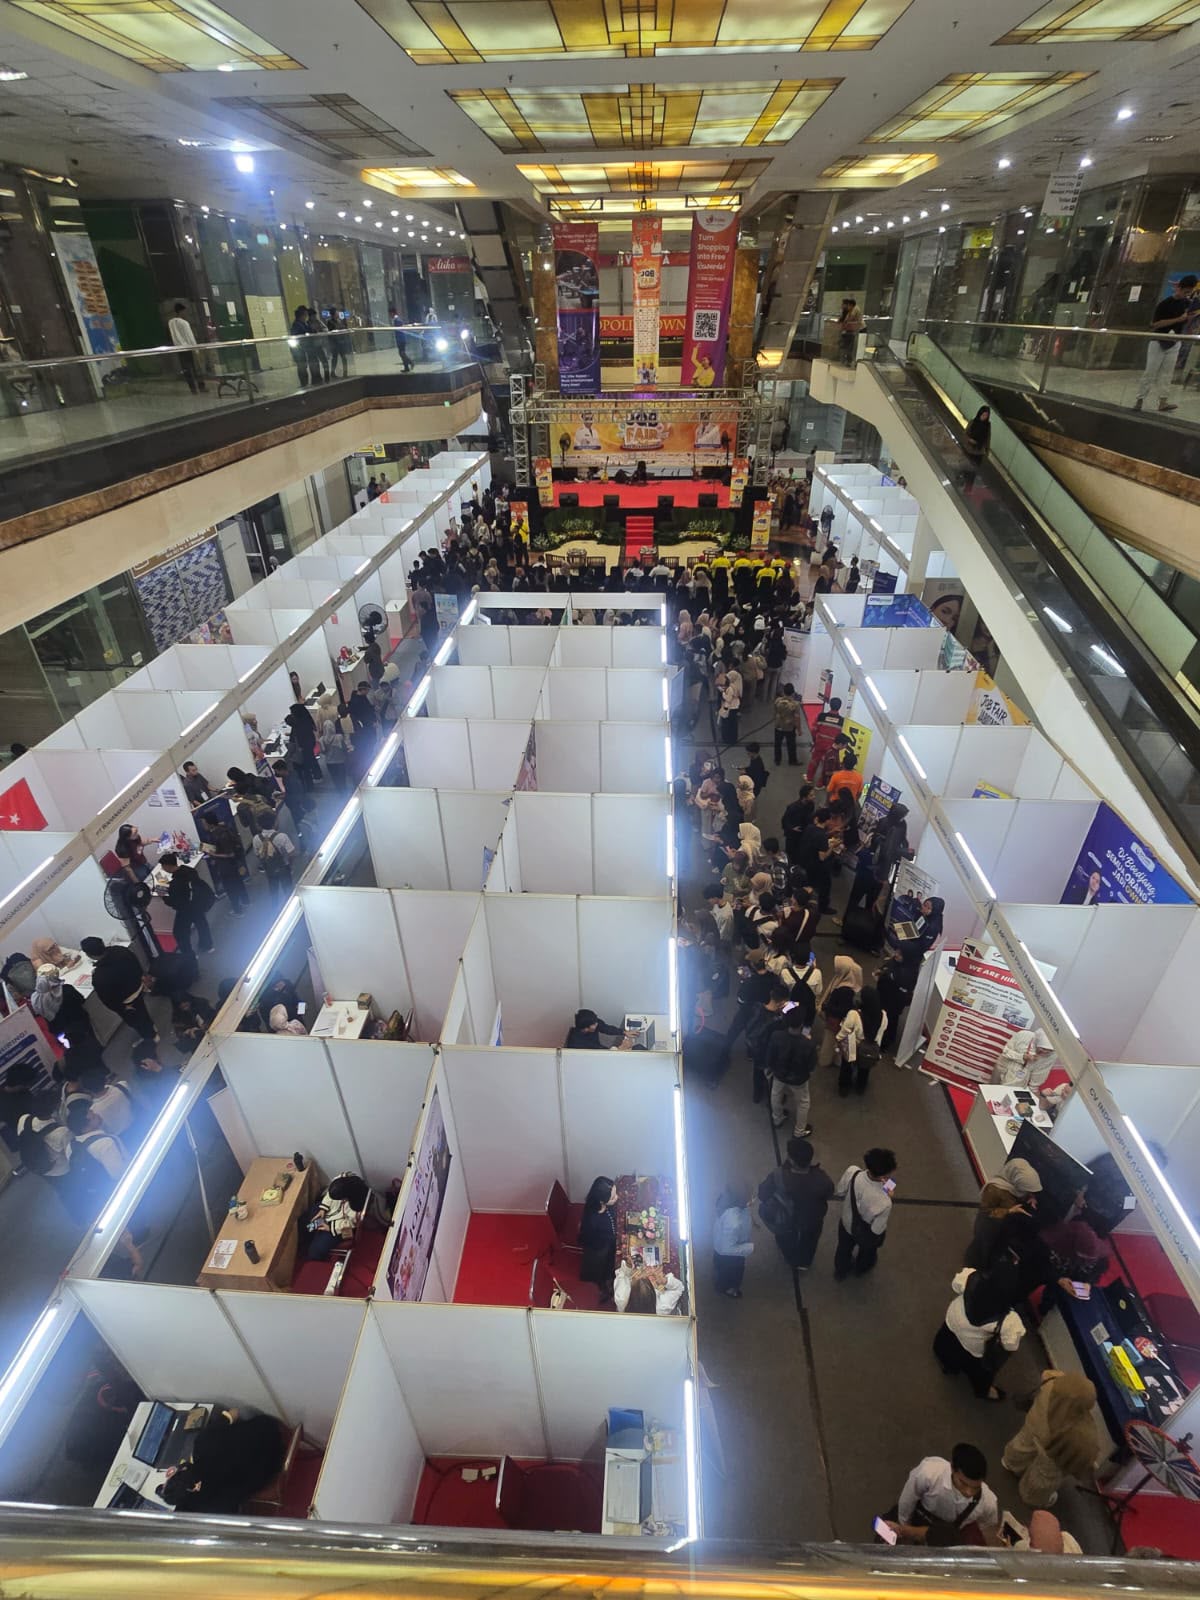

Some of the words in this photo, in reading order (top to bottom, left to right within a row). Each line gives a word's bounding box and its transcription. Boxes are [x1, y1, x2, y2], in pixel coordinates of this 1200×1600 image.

[698, 233, 714, 241] Turn
[697, 244, 730, 253] Shopping
[640, 270, 655, 278] JOB
[599, 319, 633, 331] POLI
[626, 428, 658, 444] FAIR
[980, 694, 994, 711] JOB
[992, 702, 1008, 722] FAIR
[1105, 849, 1126, 876] SEMUA
[1124, 872, 1149, 901] ORANG
[1111, 870, 1127, 889] JADI
[1125, 884, 1145, 904] OWN
[968, 964, 982, 973] WE
[983, 969, 1000, 979] ARE
[1087, 1086, 1099, 1102] CV
[1096, 1101, 1127, 1149] INDOKOPI
